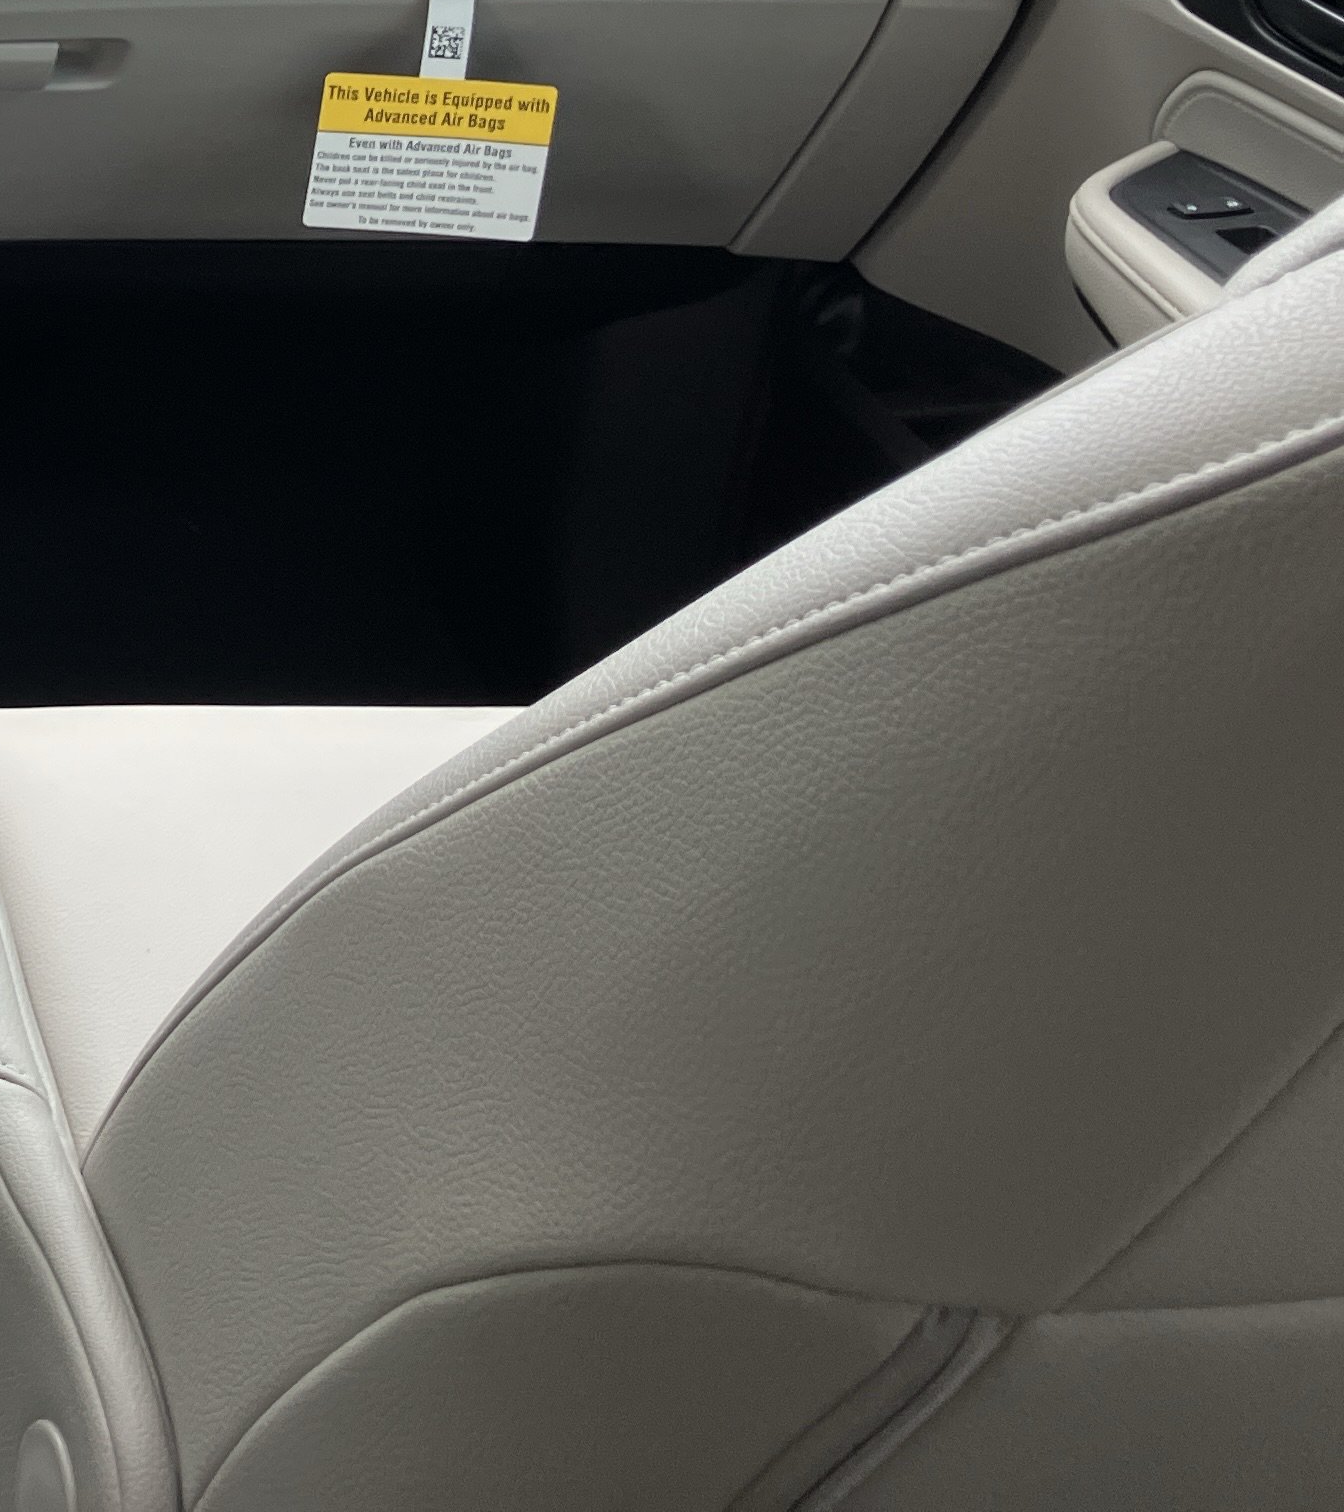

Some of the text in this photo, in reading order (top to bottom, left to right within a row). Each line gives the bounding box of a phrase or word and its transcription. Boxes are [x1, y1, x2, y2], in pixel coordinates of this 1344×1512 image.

[328, 84, 551, 114] This Vehicle is Equipped with
[364, 107, 506, 133] Advanced Air Bags
[348, 137, 513, 160] Even with Advanced Air Bags
